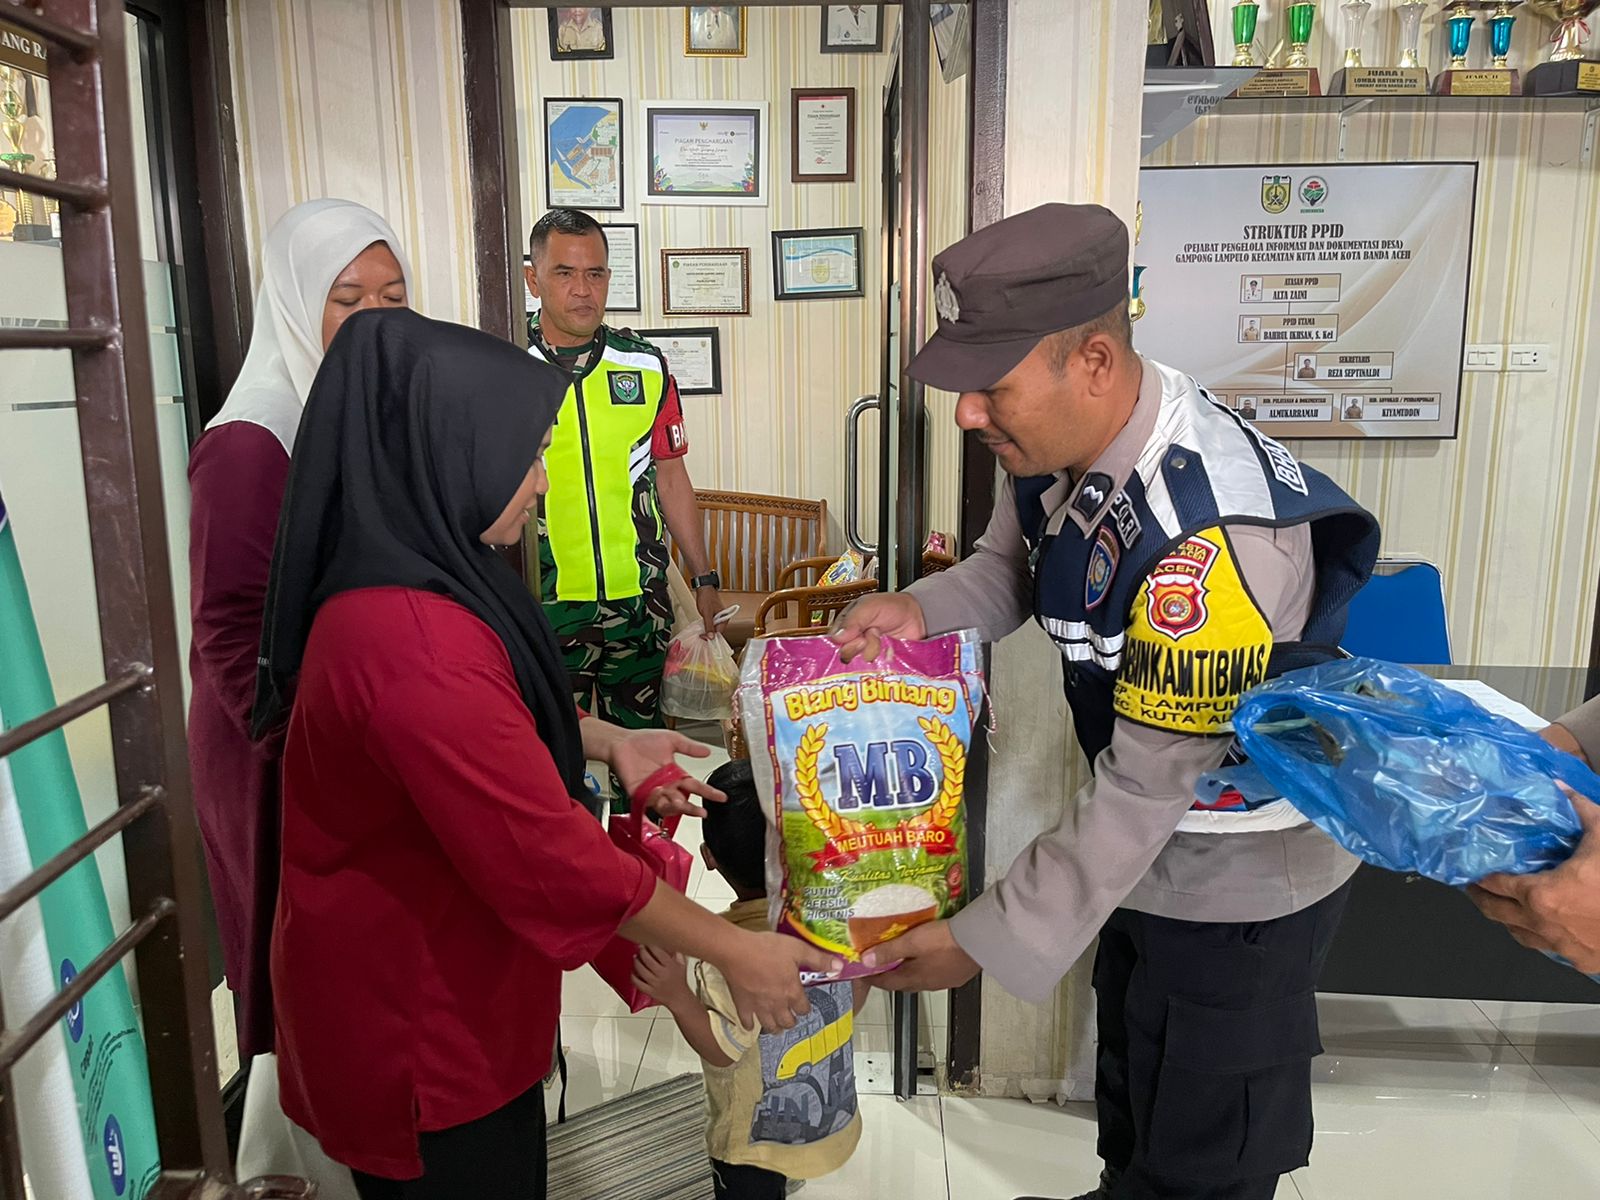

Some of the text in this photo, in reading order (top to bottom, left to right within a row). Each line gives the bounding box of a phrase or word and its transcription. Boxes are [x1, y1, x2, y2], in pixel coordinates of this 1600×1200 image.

[2, 31, 47, 60] ANG R
[1243, 223, 1344, 240] STRUKTUR PPID
[1183, 240, 1403, 253] (PEJABAT PENGELOLA INFORMASI DAN DOKUMENTASI DESA)
[1175, 250, 1411, 263] GAMPONG LAMPULO KECAMATAN KUTA ALAM KOTA BANDA ACEH
[1273, 290, 1307, 300] ALTA ZAINI
[1282, 318, 1297, 326] PPID
[1327, 369, 1344, 377] REZA
[1153, 564, 1198, 576] ACEH
[784, 682, 859, 721] Blang
[860, 675, 957, 715] Bintang
[1141, 707, 1195, 724] KUTA
[833, 740, 939, 812] MB
[837, 830, 945, 853] MEUTUAH BARO
